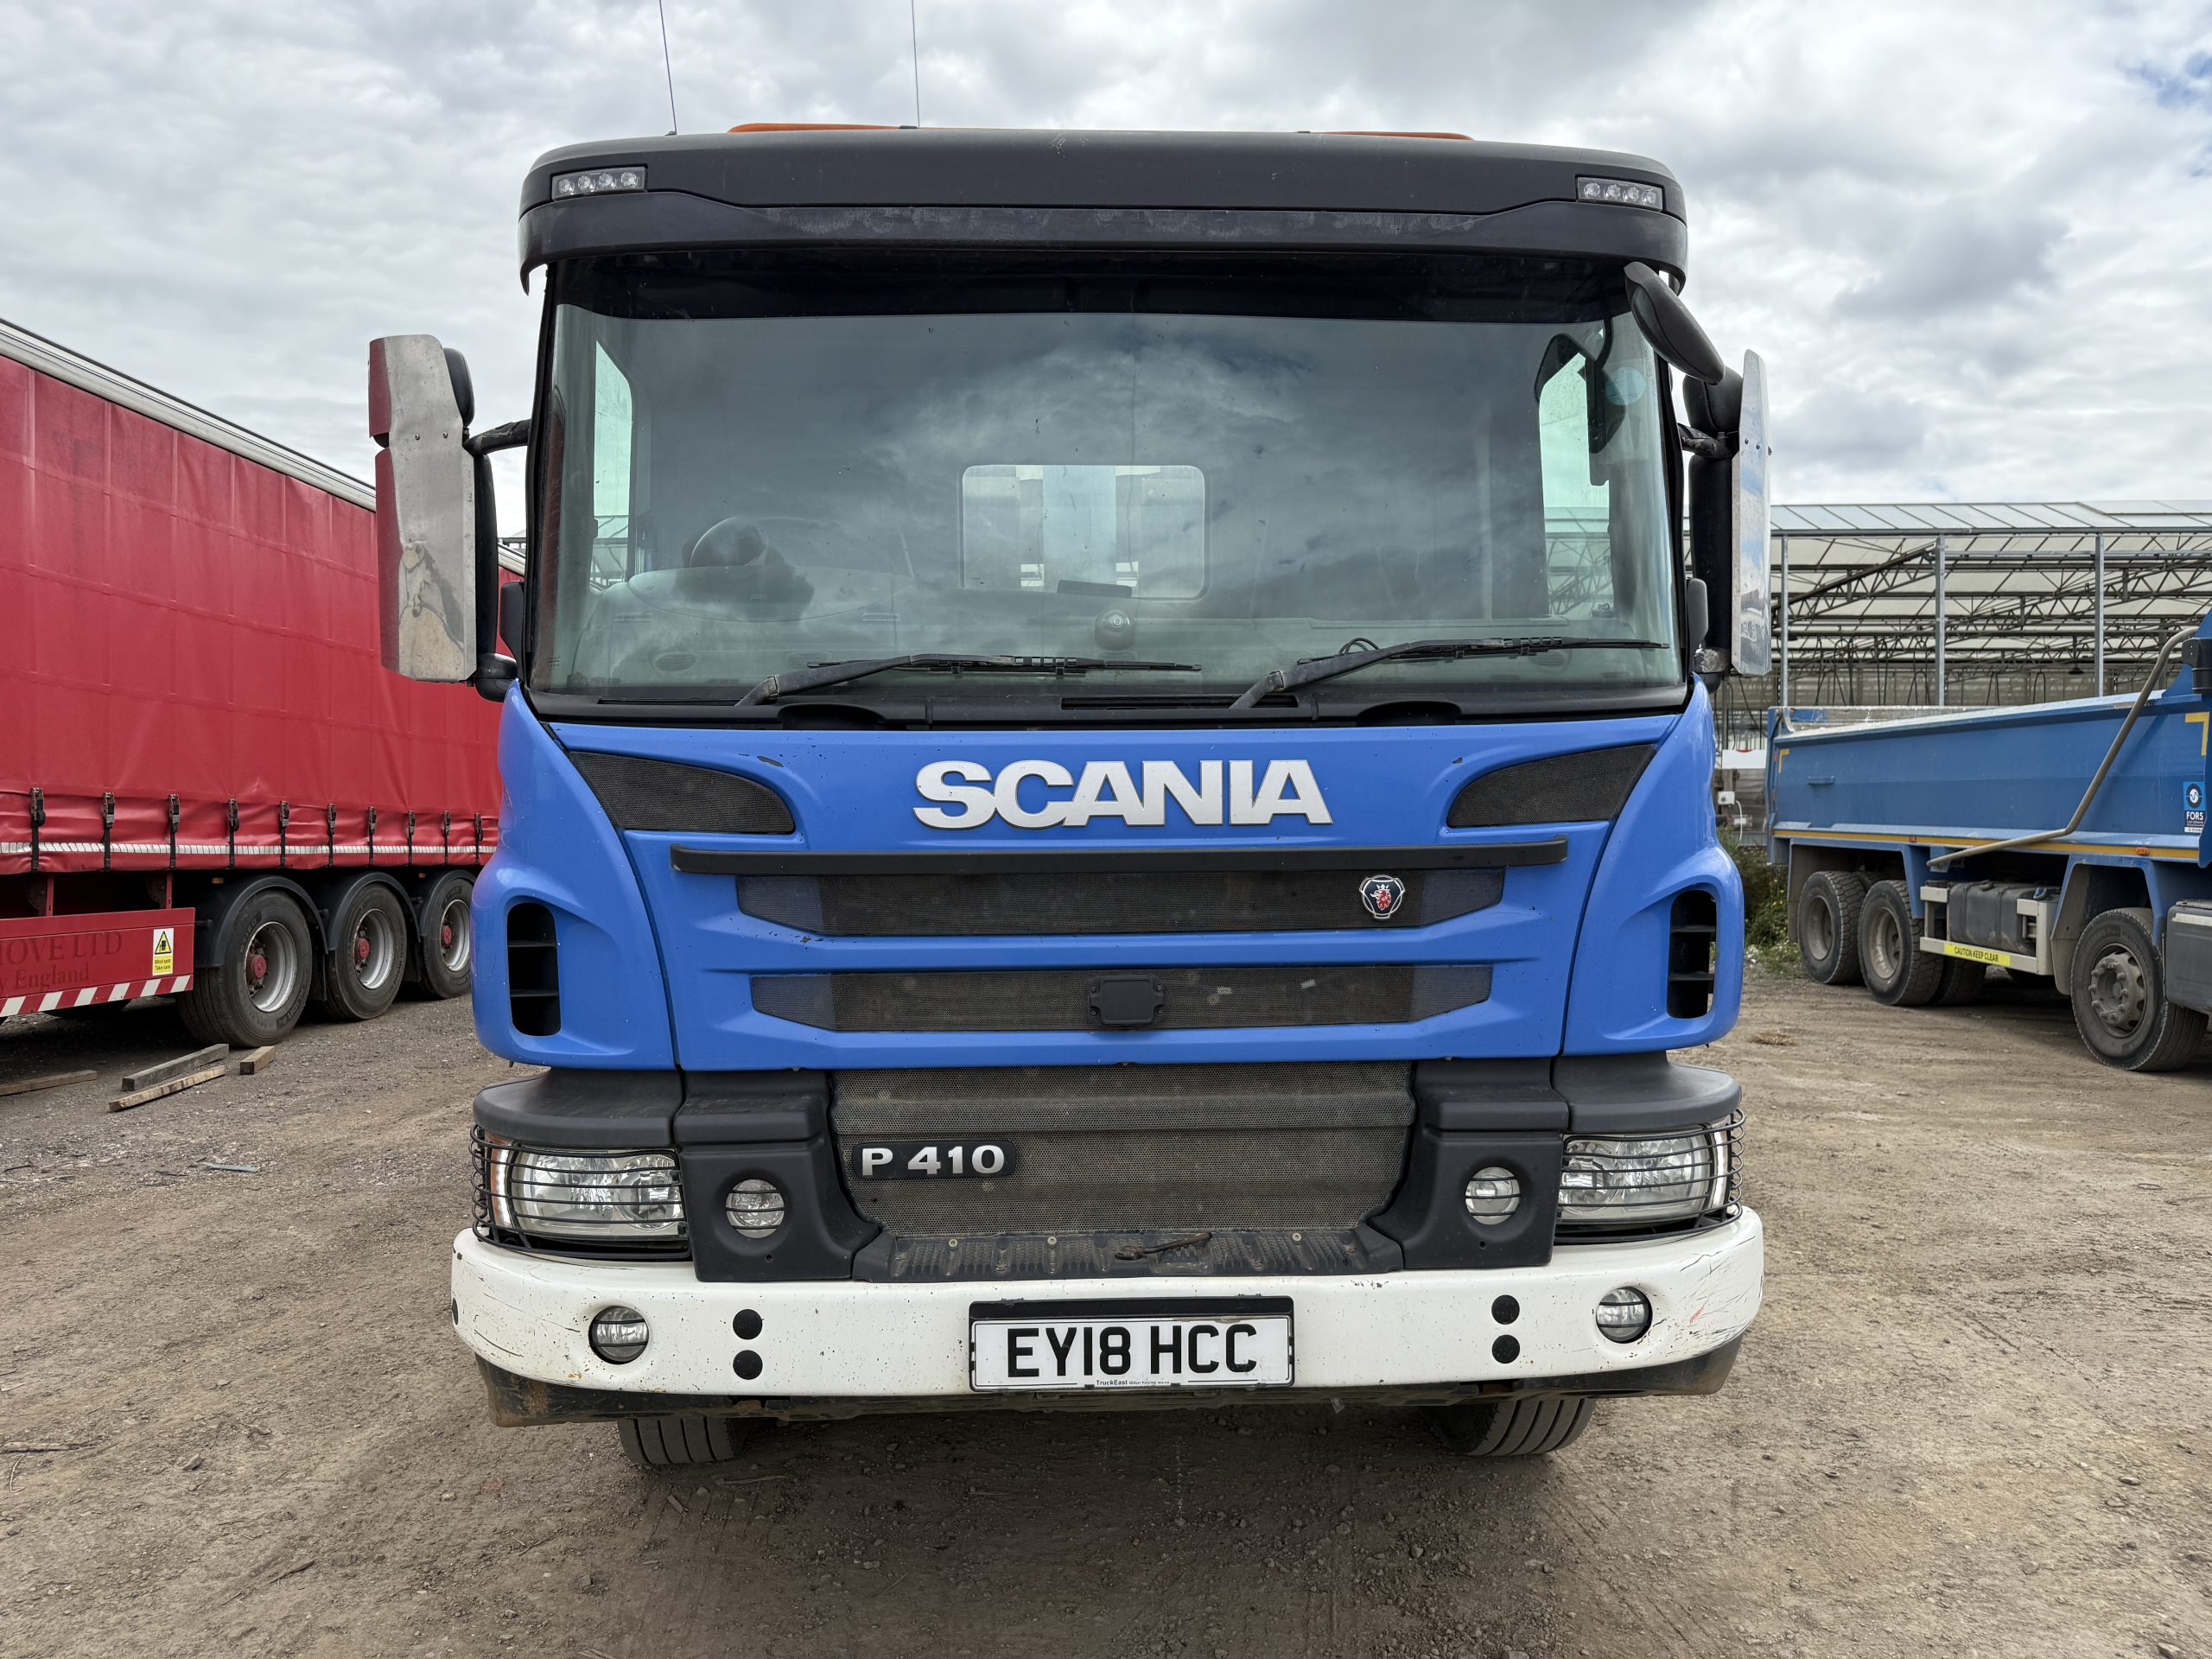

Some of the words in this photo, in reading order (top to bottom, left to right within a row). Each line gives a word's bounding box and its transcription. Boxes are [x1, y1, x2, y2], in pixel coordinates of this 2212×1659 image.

[912, 759, 1334, 830] SCANIA
[2186, 810, 2204, 821] FORS
[72, 931, 123, 958] LTD
[1954, 946, 1973, 957] CAUTION
[1973, 950, 1984, 959] KEEP
[1984, 952, 1999, 962] CLEAR
[15, 962, 90, 992] England
[861, 1147, 893, 1176] P
[907, 1145, 1005, 1175] 410
[1007, 1326, 1131, 1377] EY18
[1150, 1324, 1257, 1374] HCC
